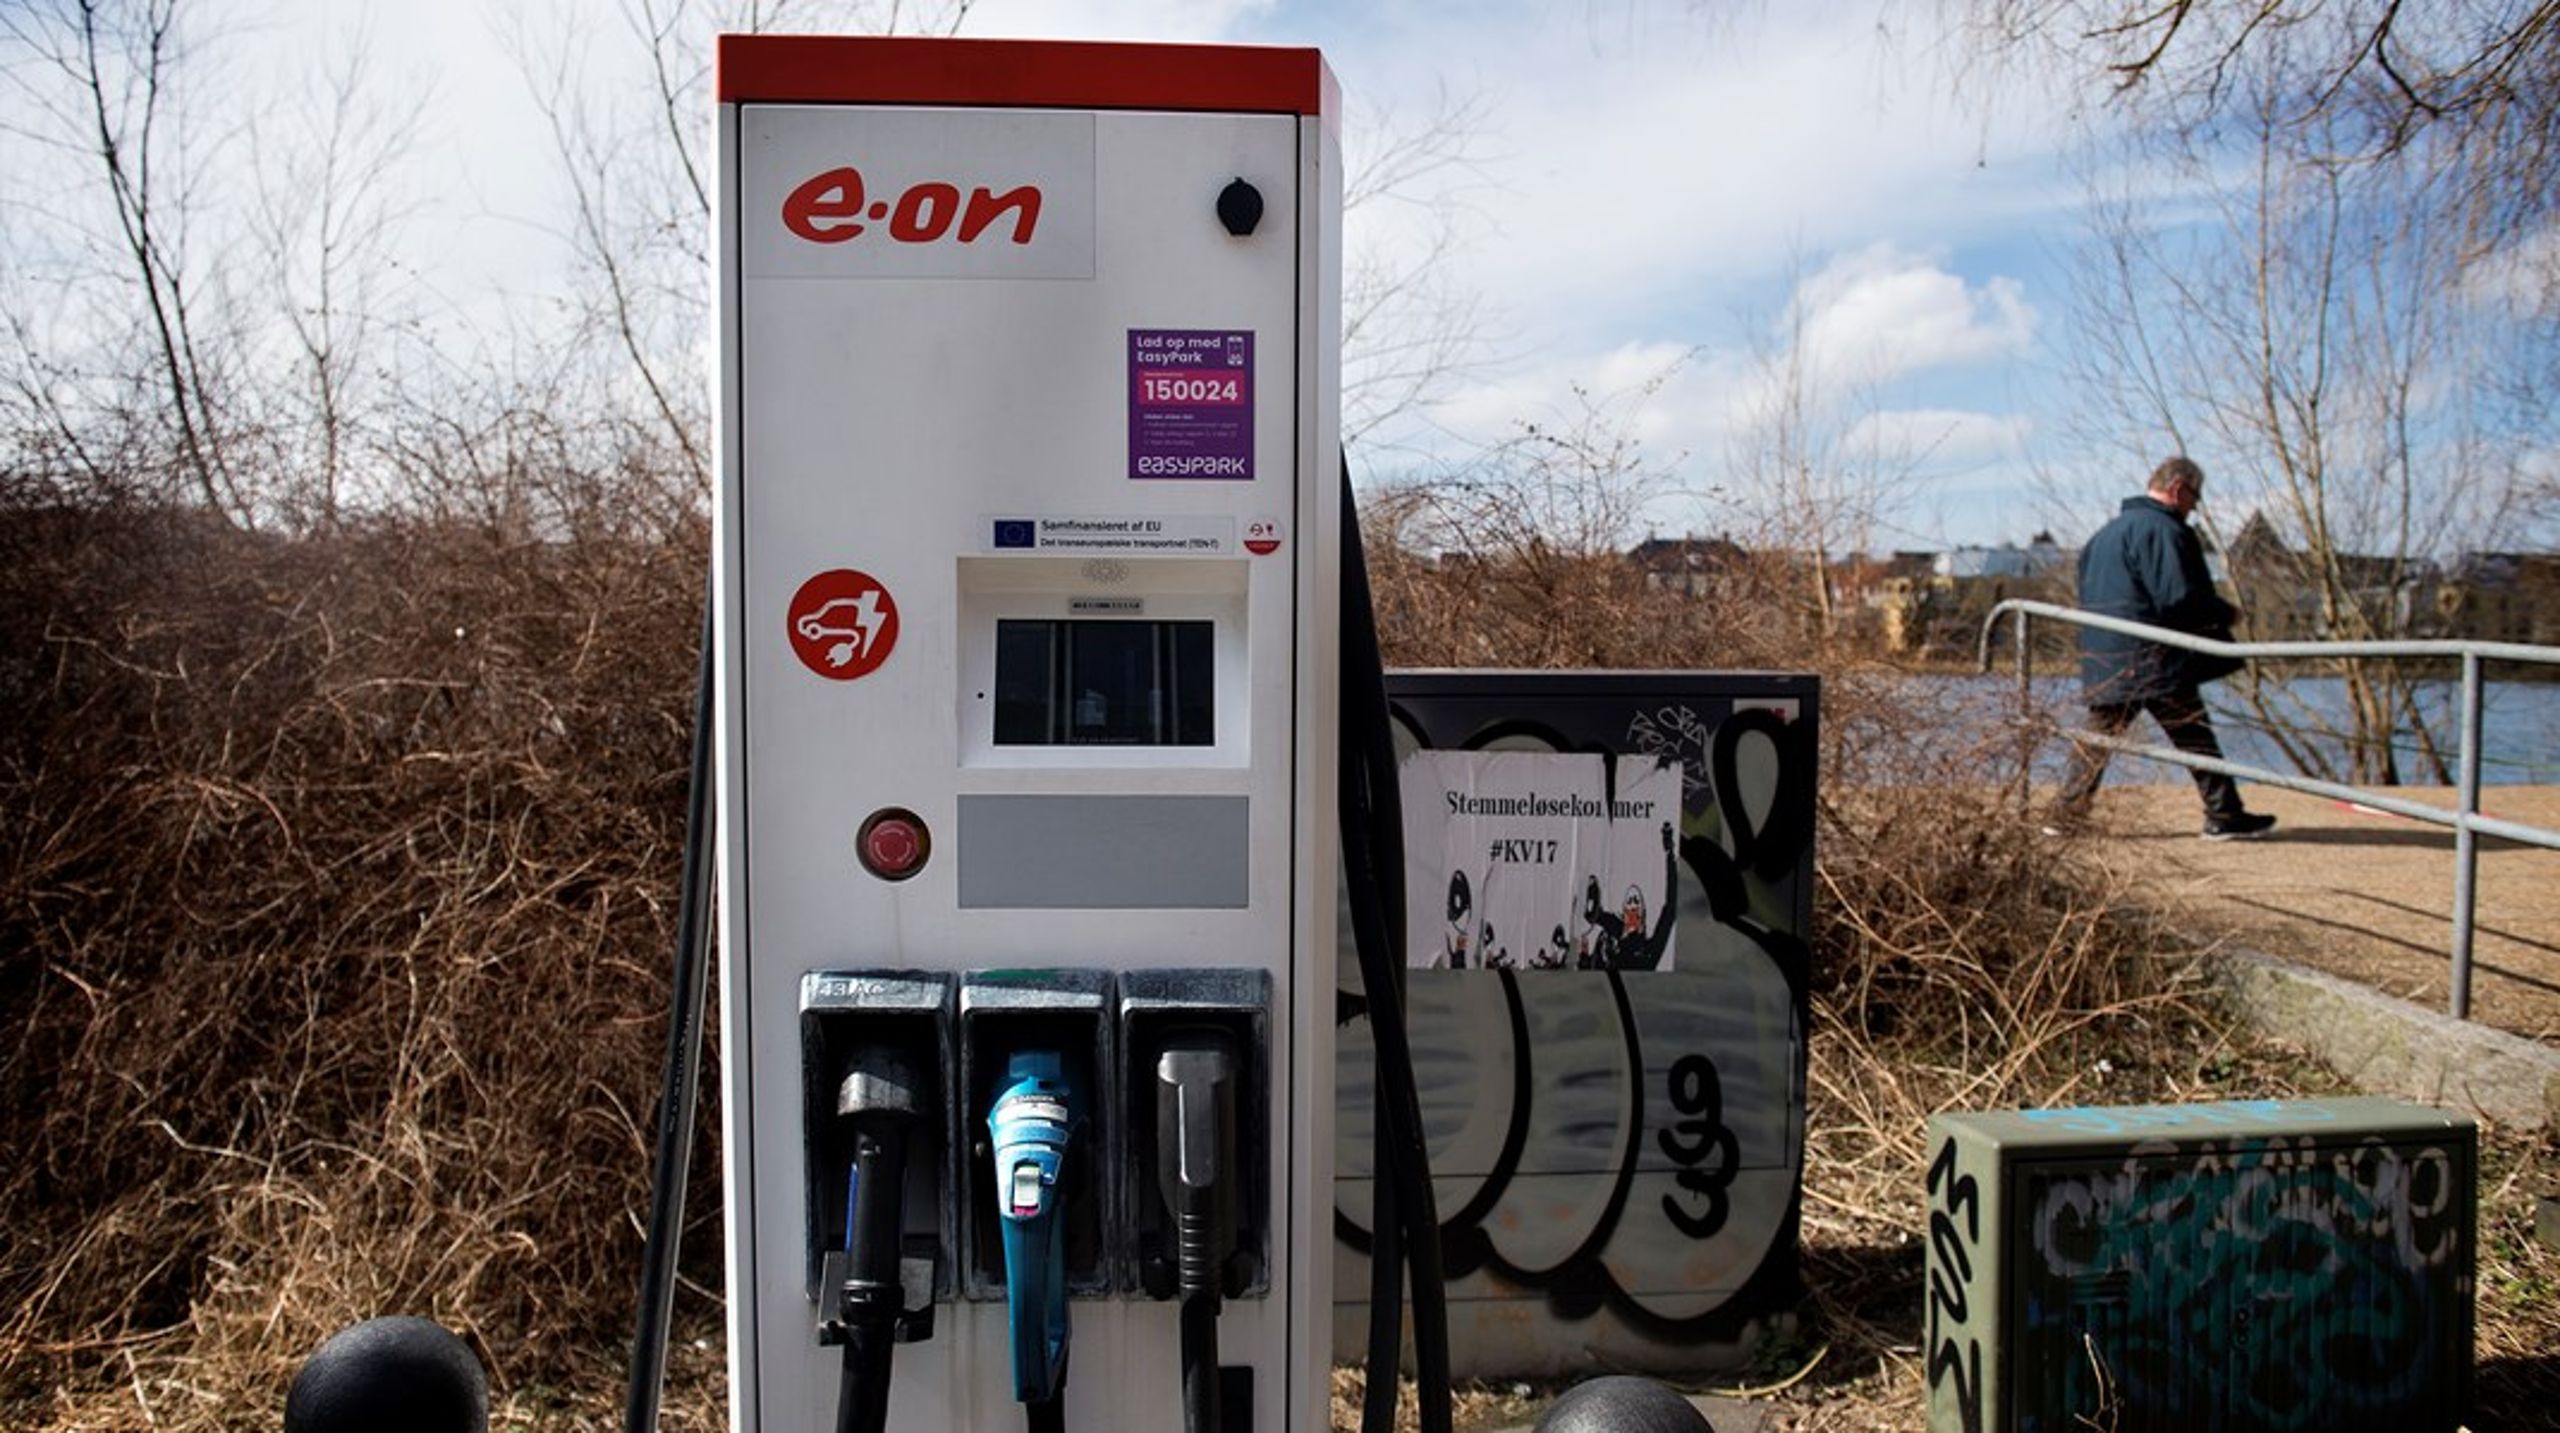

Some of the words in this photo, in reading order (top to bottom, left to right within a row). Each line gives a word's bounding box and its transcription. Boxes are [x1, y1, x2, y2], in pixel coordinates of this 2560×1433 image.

[1137, 336, 1162, 348] Lad
[1166, 339, 1185, 351] op
[1188, 337, 1221, 348] med
[1137, 351, 1202, 366] EasyPark
[1145, 379, 1238, 400] 150024
[1041, 519, 1128, 532] Samfinansieret
[1131, 520, 1144, 531] af
[1146, 521, 1161, 532] EU
[1489, 839, 1558, 864] #KV17
